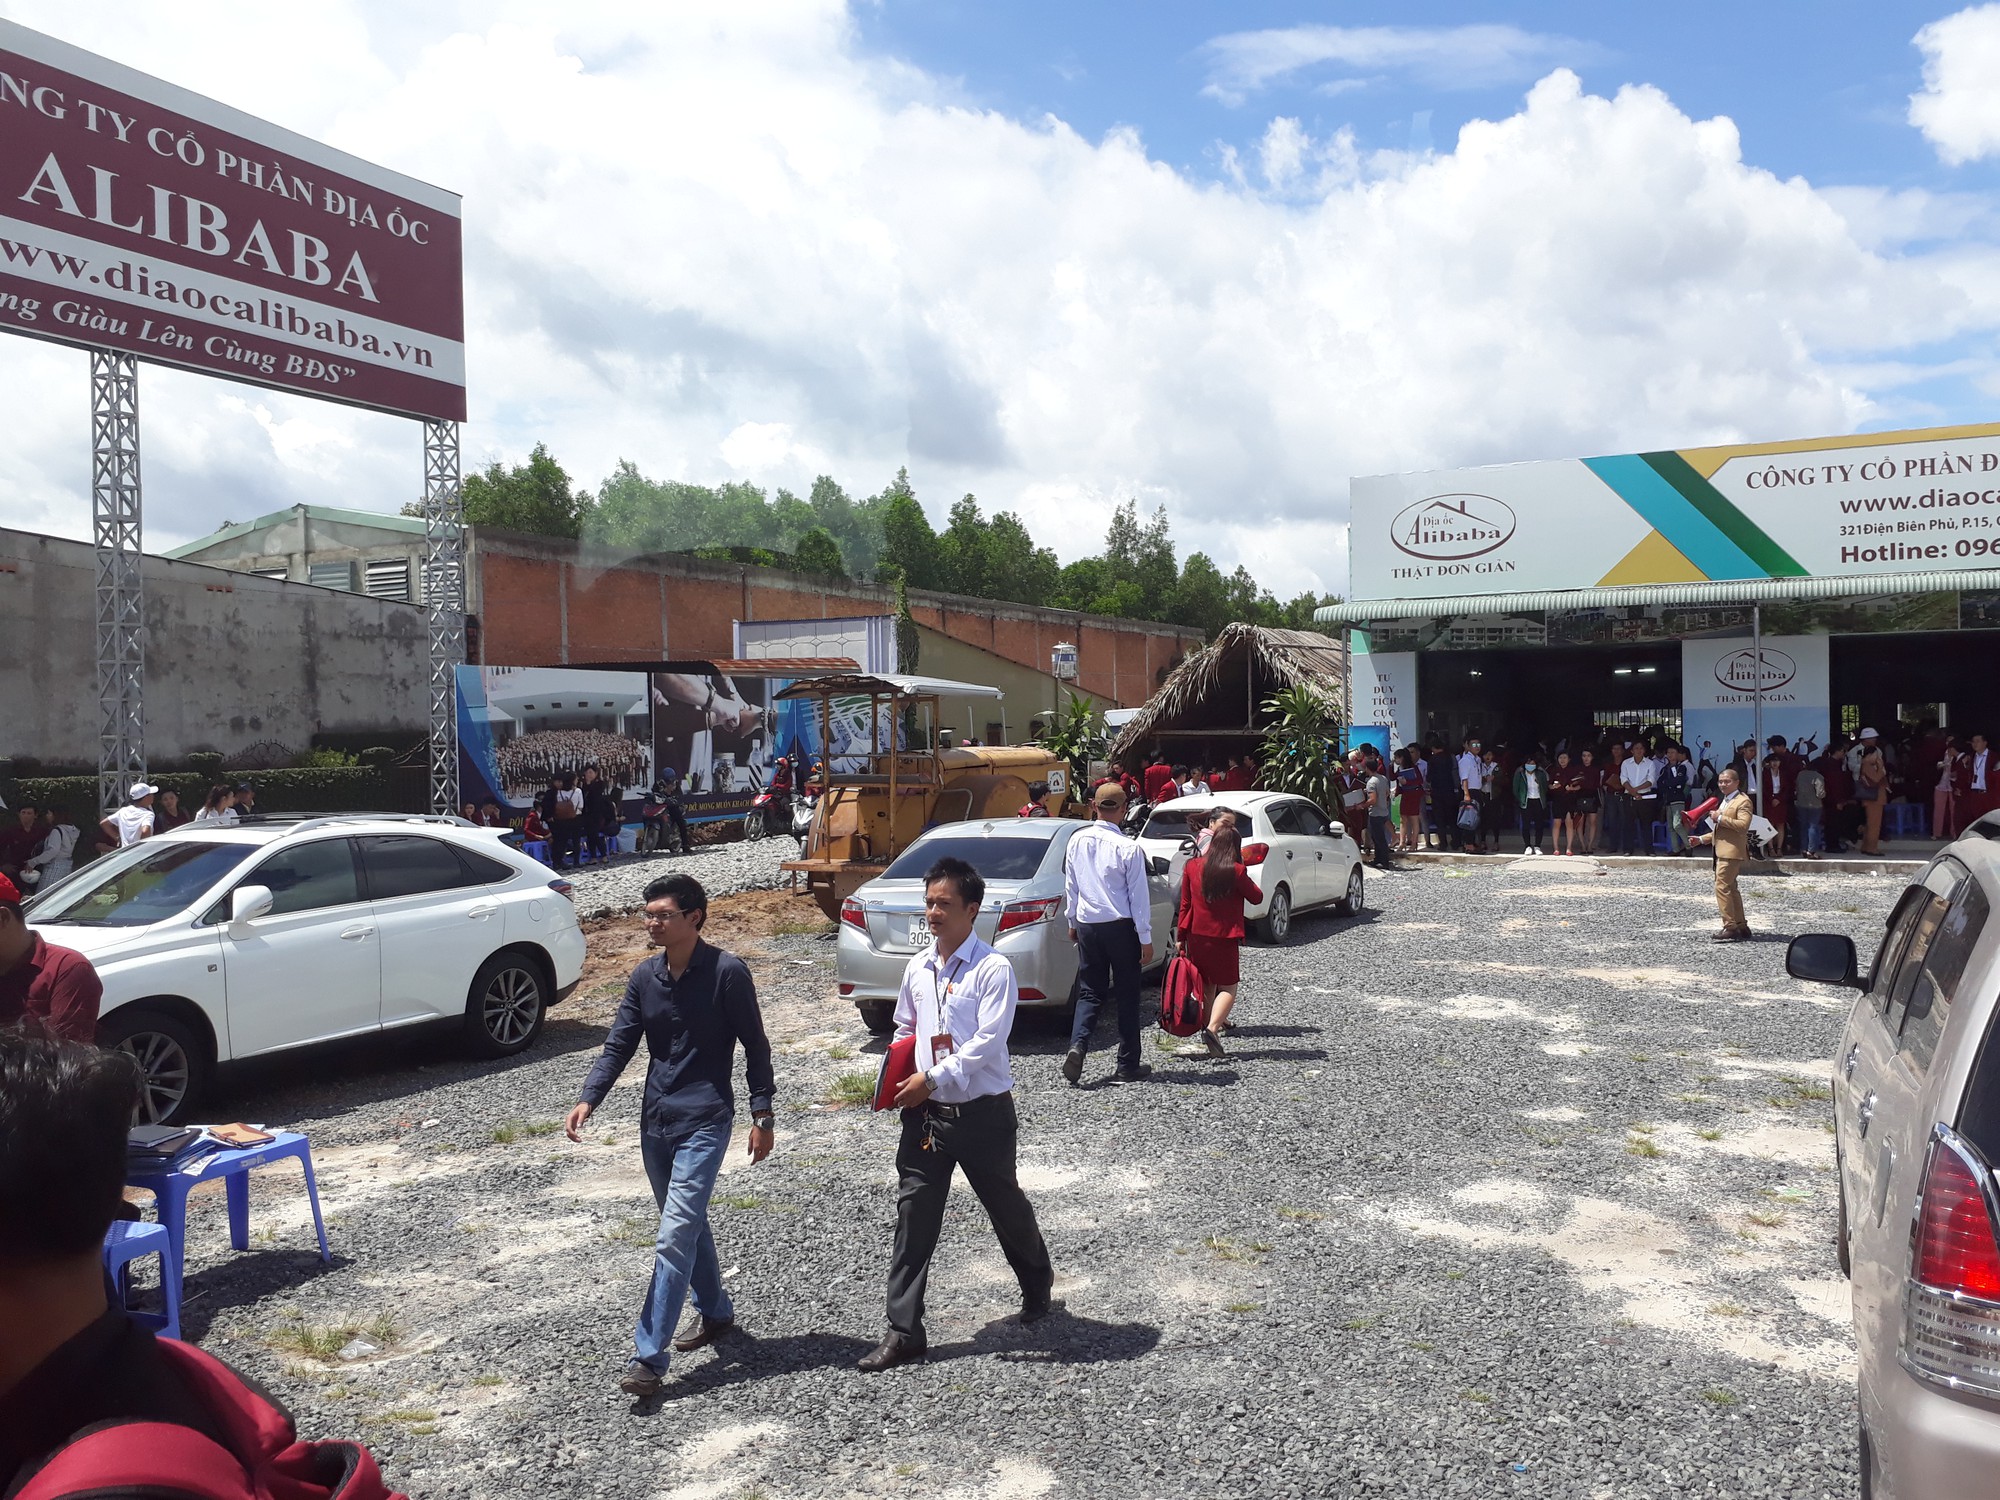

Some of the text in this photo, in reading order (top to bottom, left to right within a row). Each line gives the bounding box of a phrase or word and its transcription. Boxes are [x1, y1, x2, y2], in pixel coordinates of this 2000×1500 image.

[78, 99, 137, 143] TY
[147, 130, 205, 166] CỔ
[216, 148, 314, 206] PHẦN
[323, 187, 381, 229] ĐỊA
[386, 206, 429, 245] ỐC
[17, 151, 381, 303] ALIBABA
[52, 300, 128, 336] Giàu
[137, 319, 194, 350] Lên
[204, 336, 278, 374] Cùng
[1746, 451, 2000, 489] CÔNG TY CỔ PHẦN Đ
[1404, 513, 1501, 545] Alibaba
[1897, 521, 1926, 532] Biên
[1929, 517, 1958, 531] Phủ,
[1962, 516, 1993, 529] P.15,
[1841, 542, 1948, 563] Hotline:
[1391, 559, 1516, 580] THẬT ĐƠN GIẢN
[1374, 685, 1395, 694] DUY
[1715, 693, 1742, 704] THẬT
[1371, 696, 1397, 705] TÍCH
[1373, 707, 1396, 719] CỰC
